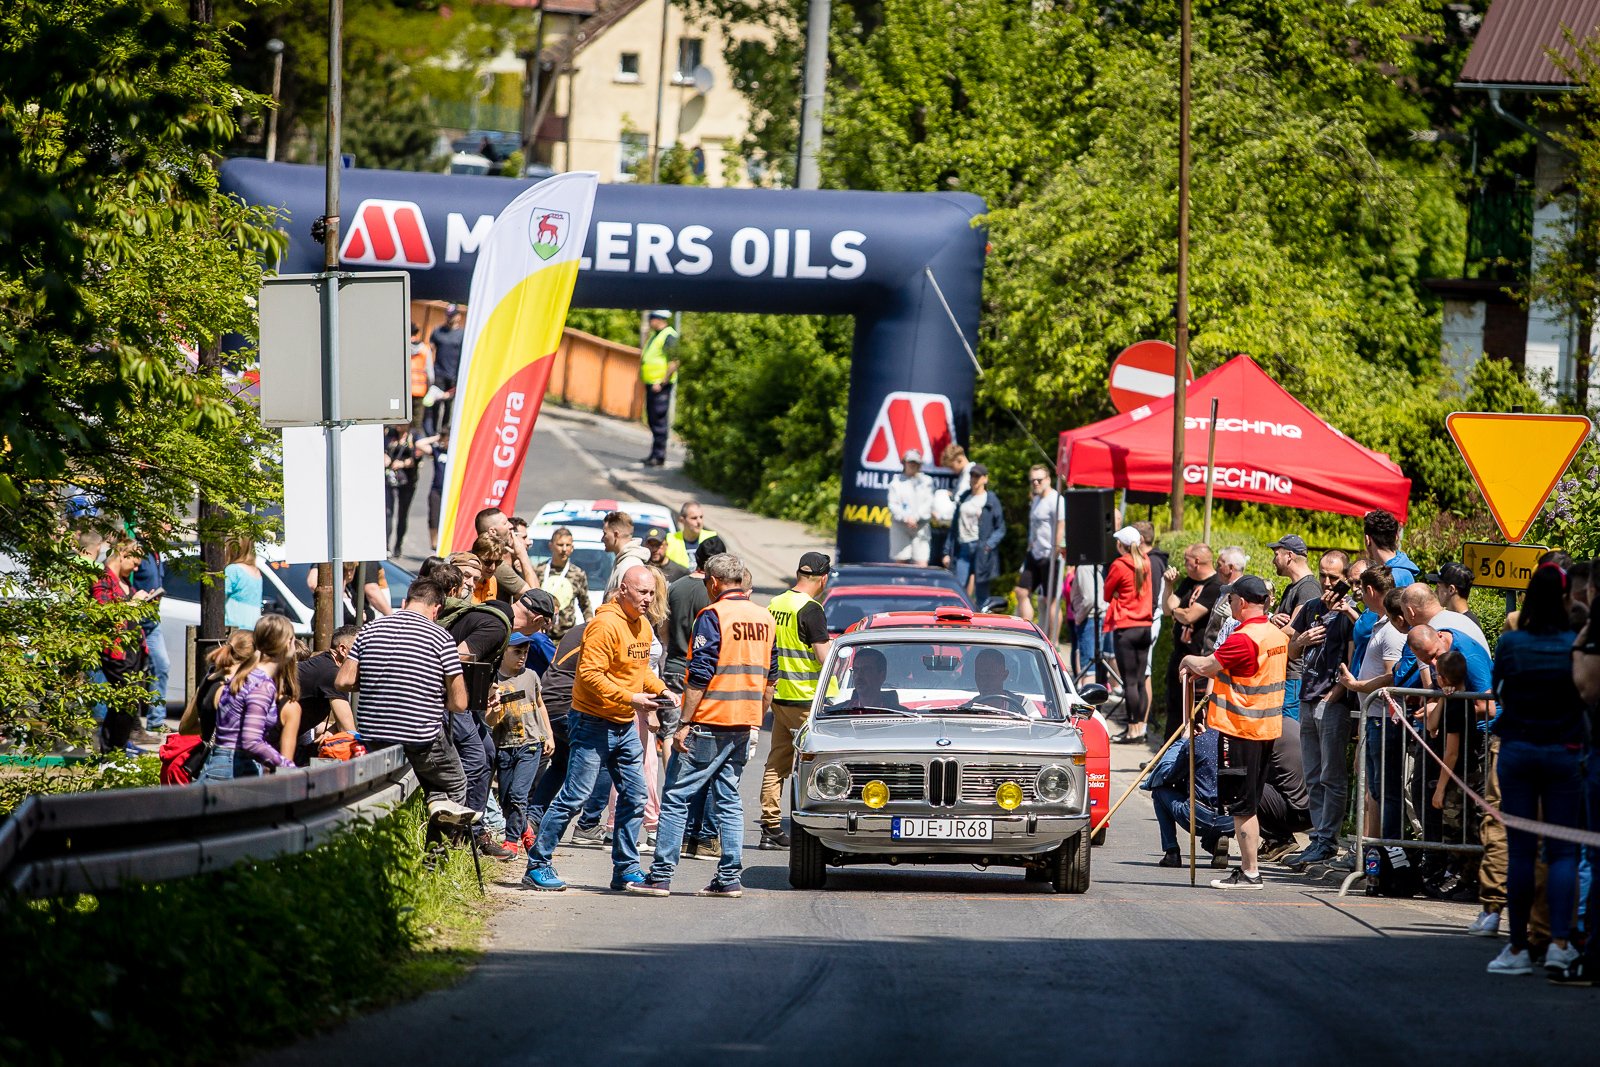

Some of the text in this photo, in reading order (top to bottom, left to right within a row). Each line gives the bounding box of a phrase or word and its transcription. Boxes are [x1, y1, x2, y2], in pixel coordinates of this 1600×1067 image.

[445, 212, 868, 280] MERS OILS
[492, 391, 525, 468] Góra
[1509, 561, 1532, 580] km
[732, 621, 769, 643] START
[904, 820, 987, 838] DJE JR68
